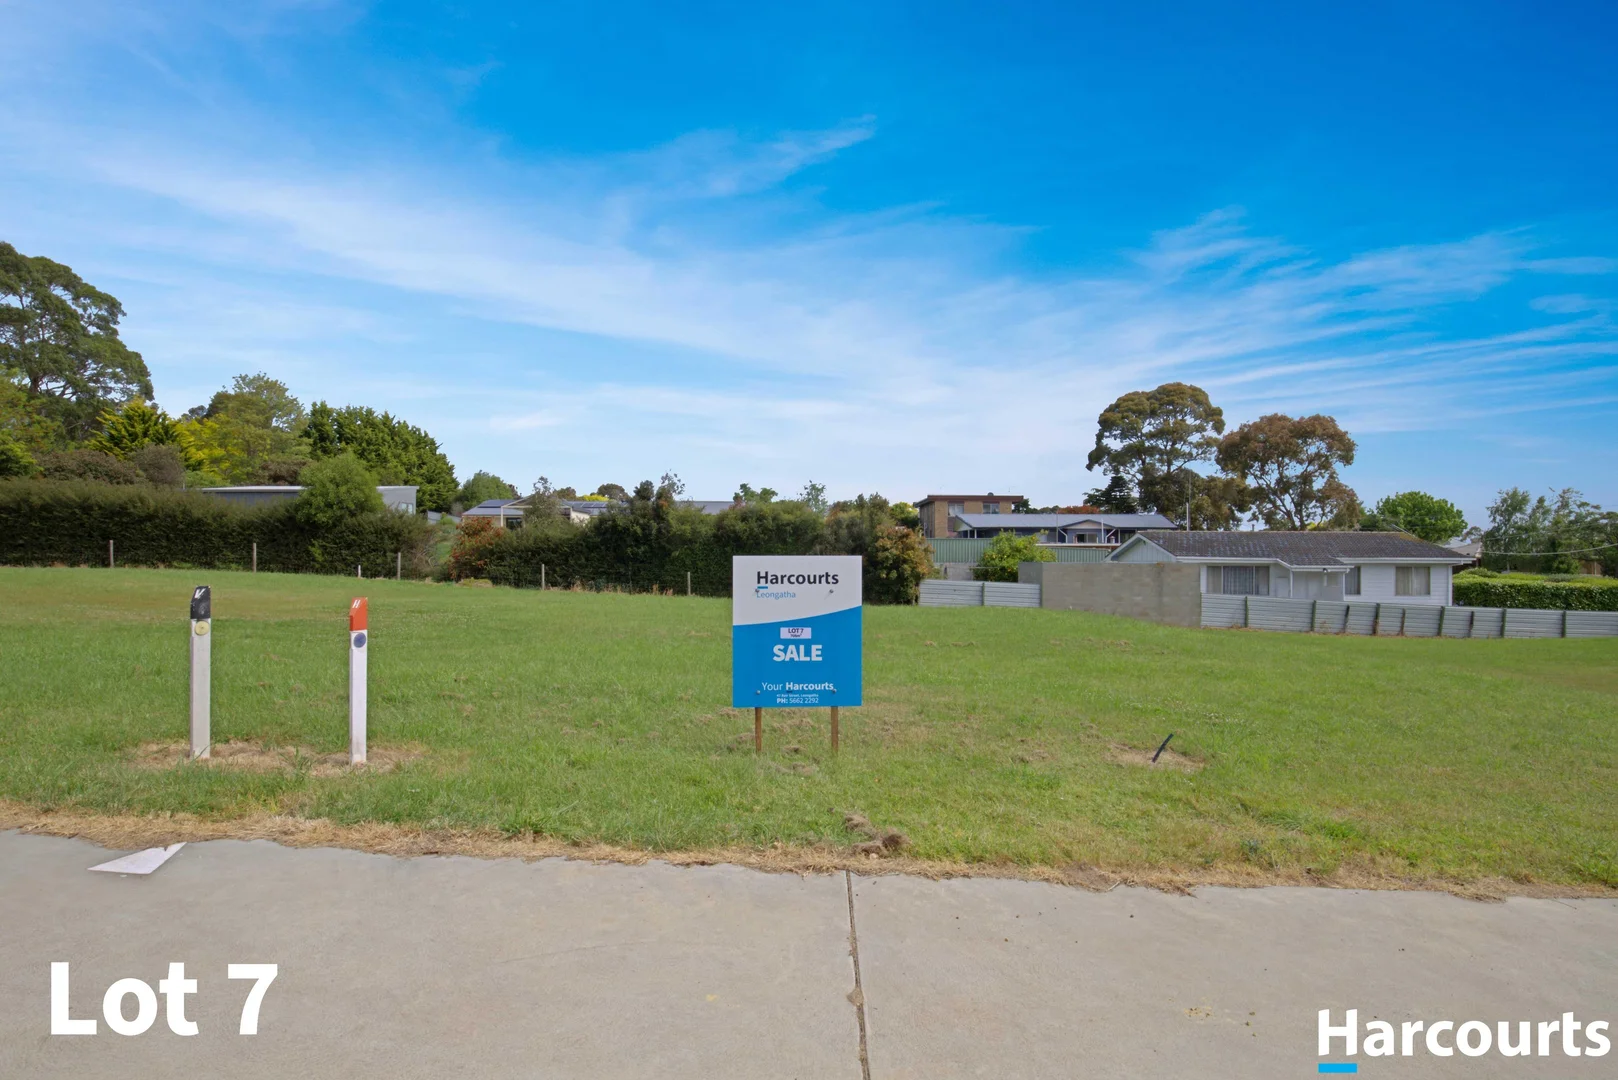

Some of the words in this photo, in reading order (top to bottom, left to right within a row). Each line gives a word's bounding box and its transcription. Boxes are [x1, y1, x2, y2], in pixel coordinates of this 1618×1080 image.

[757, 571, 839, 584] Harcourts
[756, 591, 796, 600] Leongatha
[772, 644, 823, 661] SALE
[761, 682, 783, 691] Your
[785, 681, 834, 691] Harcourts
